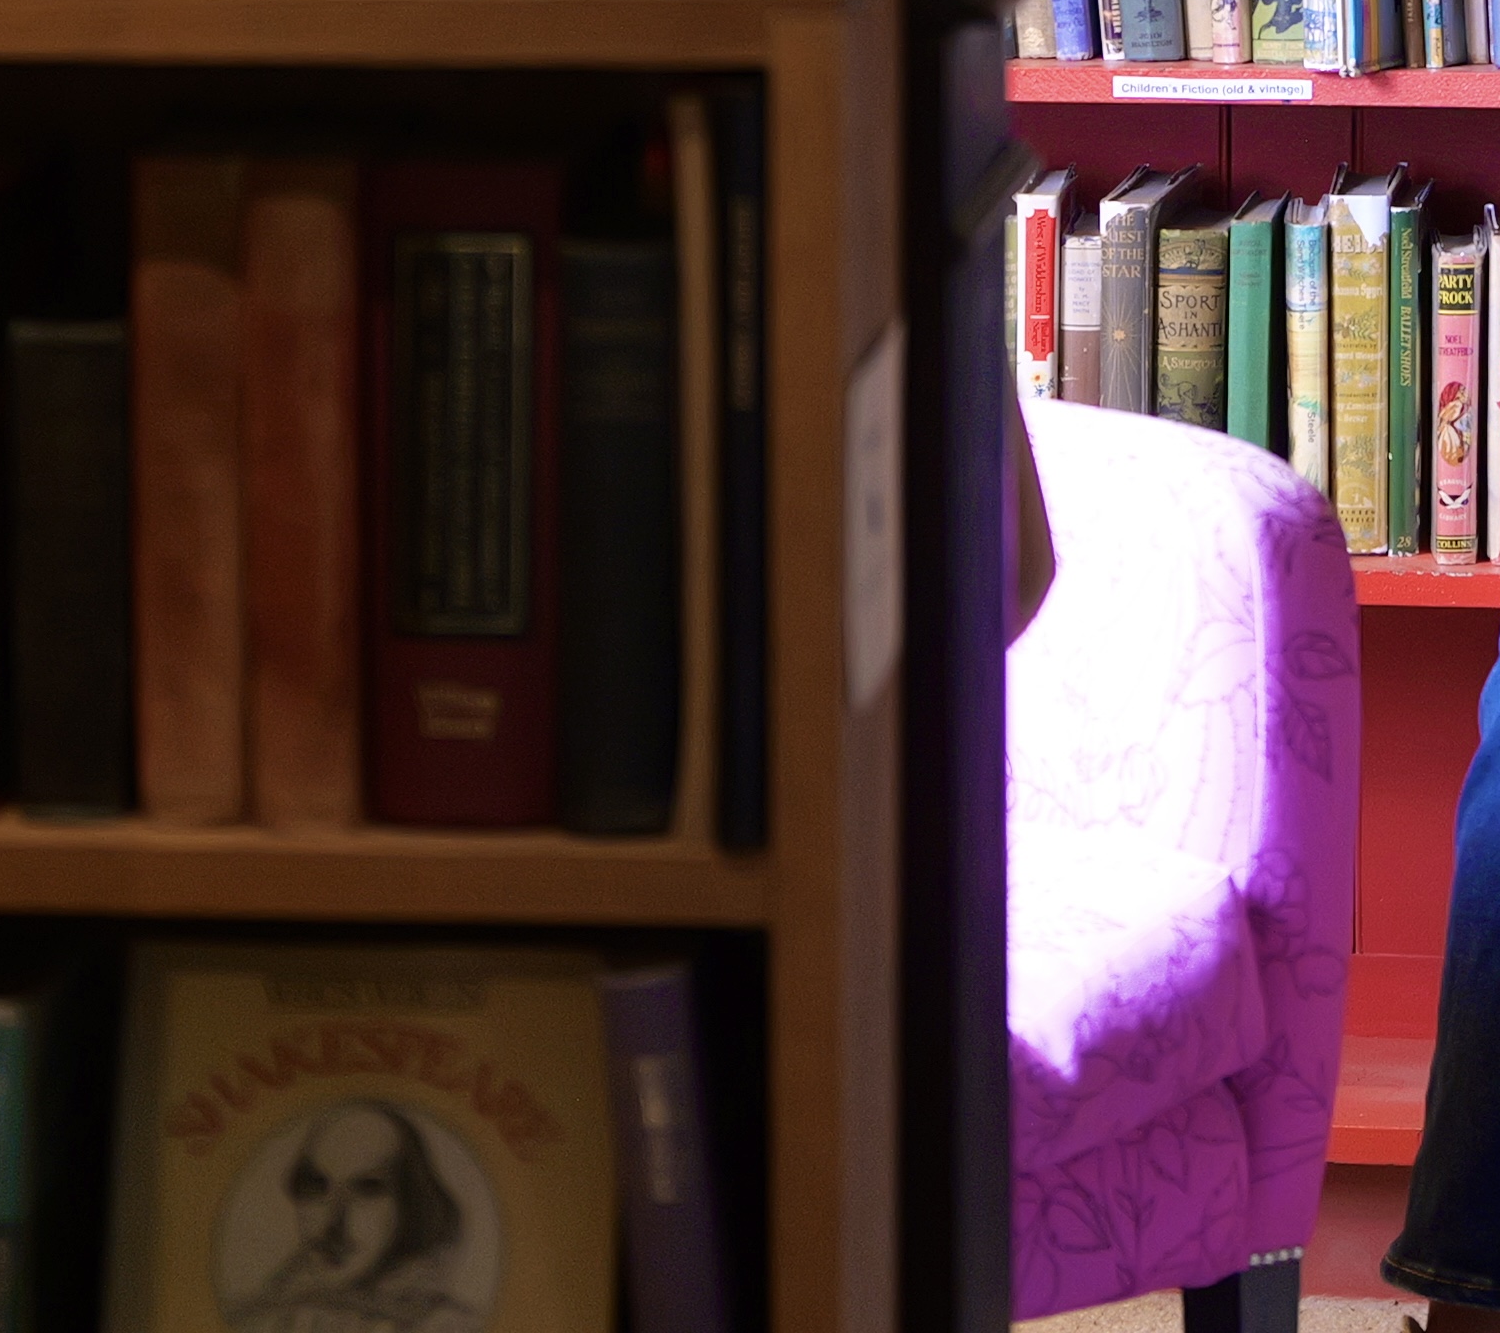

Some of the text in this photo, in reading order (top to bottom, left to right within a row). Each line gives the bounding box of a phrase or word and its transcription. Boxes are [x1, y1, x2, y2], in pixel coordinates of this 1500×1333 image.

[1121, 84, 1178, 93] Children's
[1182, 85, 1218, 94] Fiction
[1222, 85, 1244, 96] (old
[1259, 85, 1304, 96] vintage)
[1102, 248, 1145, 261] OF THE
[1102, 265, 1142, 278] STAR
[1438, 275, 1474, 290] PARTY
[1160, 290, 1221, 312] SPORT
[1184, 310, 1198, 320] IN
[1444, 335, 1462, 344] NOEL
[1307, 411, 1317, 443] Steele
[1396, 536, 1412, 548] 28
[1436, 540, 1473, 549] COLLINS
[167, 1018, 570, 1164] SHAKESPEARE
